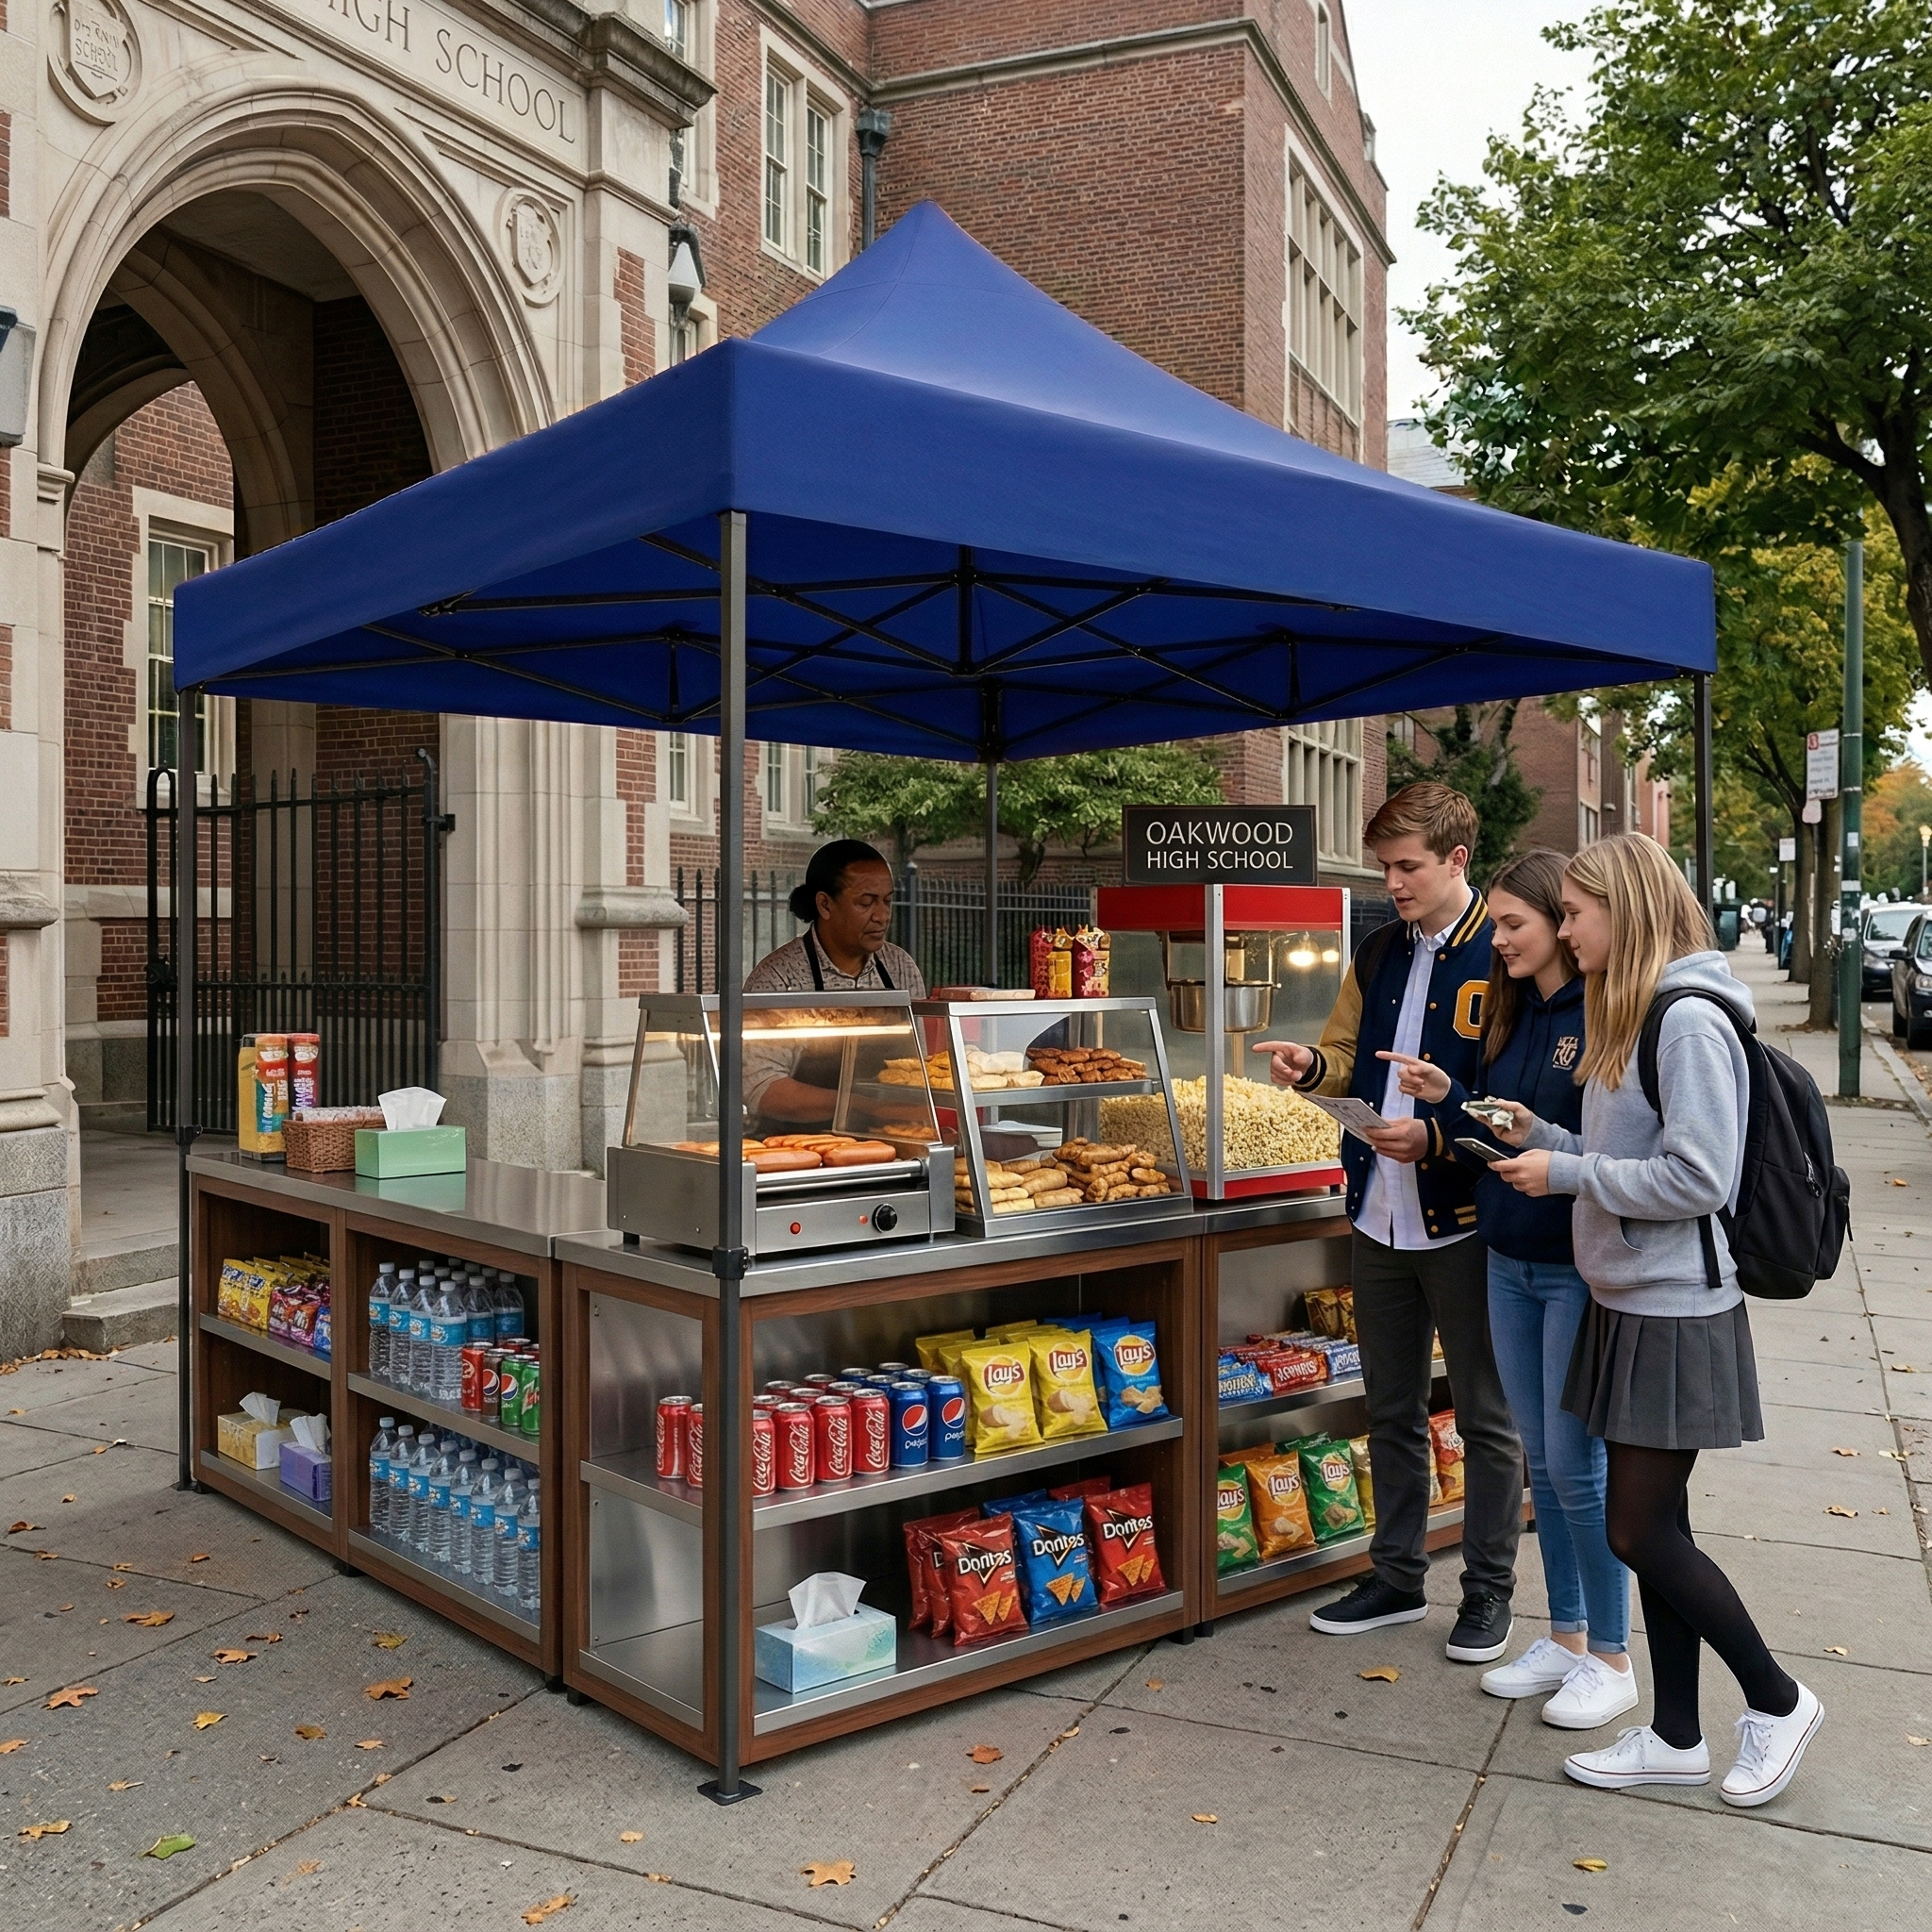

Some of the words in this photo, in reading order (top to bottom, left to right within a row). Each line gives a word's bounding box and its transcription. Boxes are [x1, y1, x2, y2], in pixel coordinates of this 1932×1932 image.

[436, 28, 575, 144] SCHOOL
[1146, 821, 1293, 845] OAKWOOD
[1147, 851, 1199, 869] HIGH
[1207, 850, 1293, 869] SCHOOL
